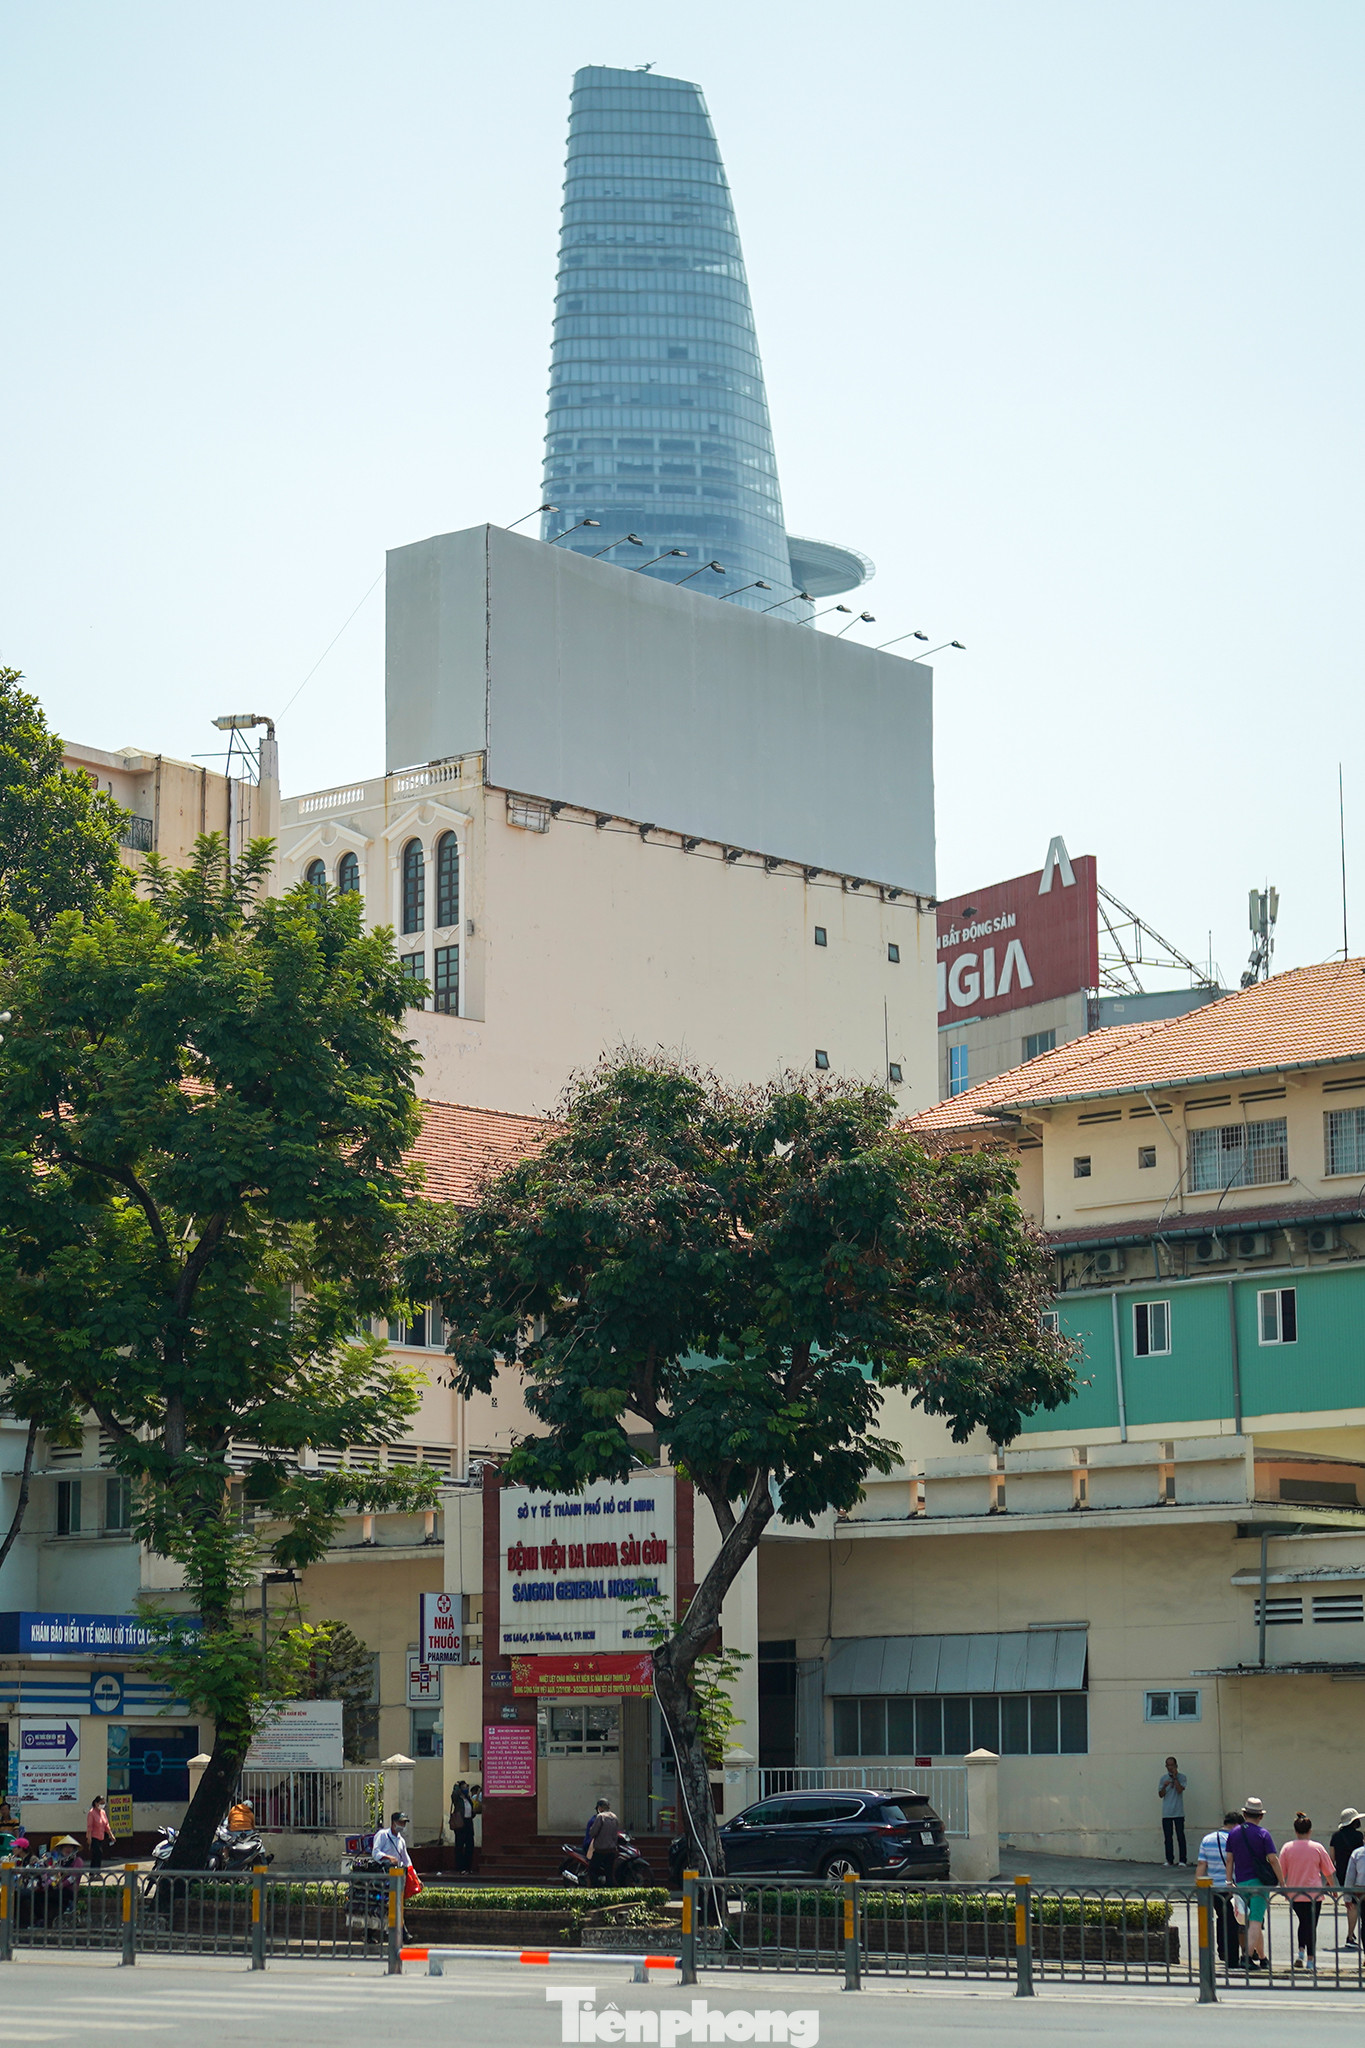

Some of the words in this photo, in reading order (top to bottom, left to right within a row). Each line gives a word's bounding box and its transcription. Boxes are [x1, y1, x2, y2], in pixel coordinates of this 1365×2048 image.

[942, 923, 962, 949] BẤT
[962, 920, 992, 943] ĐỘNG
[993, 912, 1016, 932] SẢN
[531, 1505, 537, 1519] Y
[540, 1500, 552, 1518] TẾ
[553, 1501, 581, 1517] THÀNH
[583, 1497, 601, 1515] PHỐ
[617, 1497, 632, 1514] CHÍ
[633, 1499, 655, 1513] MINH
[507, 1541, 538, 1576] BỆNH
[540, 1538, 566, 1575] VIỆN
[568, 1544, 585, 1568] ĐA
[586, 1542, 618, 1568] KHOA
[620, 1533, 641, 1566] SÀI
[642, 1532, 667, 1565] GÒN
[512, 1582, 555, 1602] SAIGON
[556, 1580, 606, 1601] GENERAL
[31, 1620, 49, 1642] KHÁM
[50, 1618, 63, 1642] BẢO
[63, 1617, 79, 1643] HIỂM
[80, 1627, 86, 1643] Y
[86, 1621, 95, 1643] TẾ
[95, 1623, 113, 1644] NGOÀI
[113, 1621, 125, 1645] GIỜ
[125, 1620, 137, 1645] TẤT
[434, 1614, 455, 1630] NHÀ
[428, 1631, 460, 1649] THUỐC
[427, 1652, 461, 1662] PHARMACY
